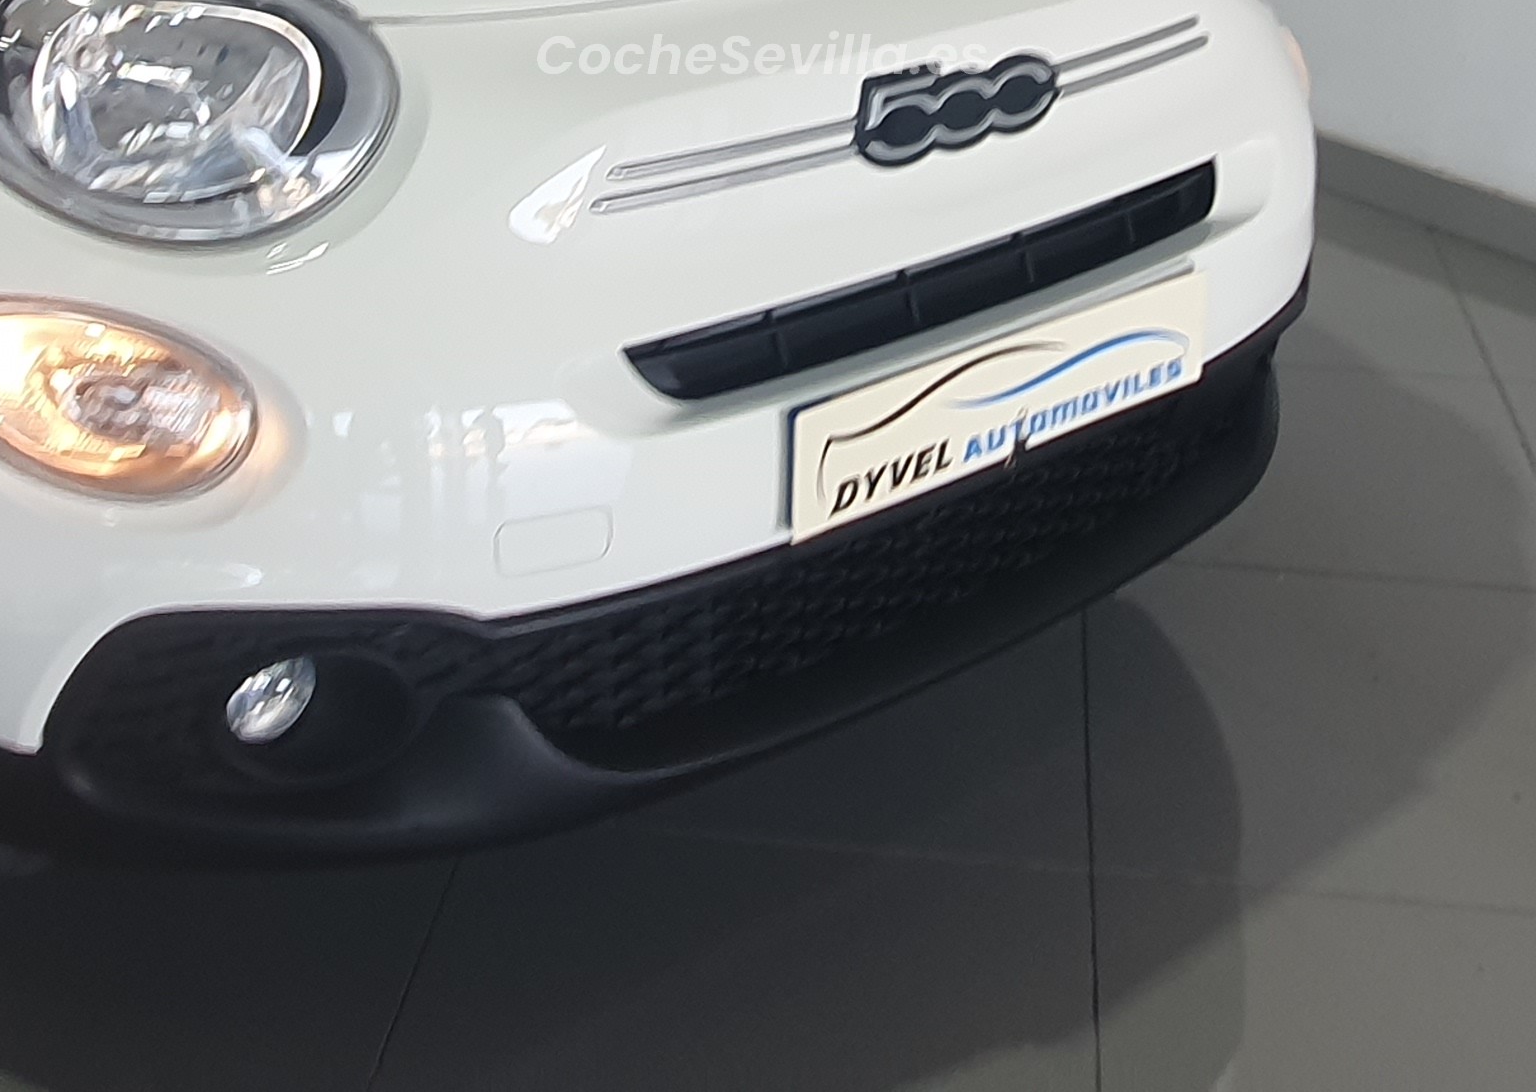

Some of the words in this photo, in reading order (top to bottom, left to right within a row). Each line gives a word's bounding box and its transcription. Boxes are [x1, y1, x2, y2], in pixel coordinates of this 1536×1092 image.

[855, 48, 1058, 167] 500
[828, 437, 953, 520] DYVEL
[962, 358, 1183, 464] AUTOMOVILES
